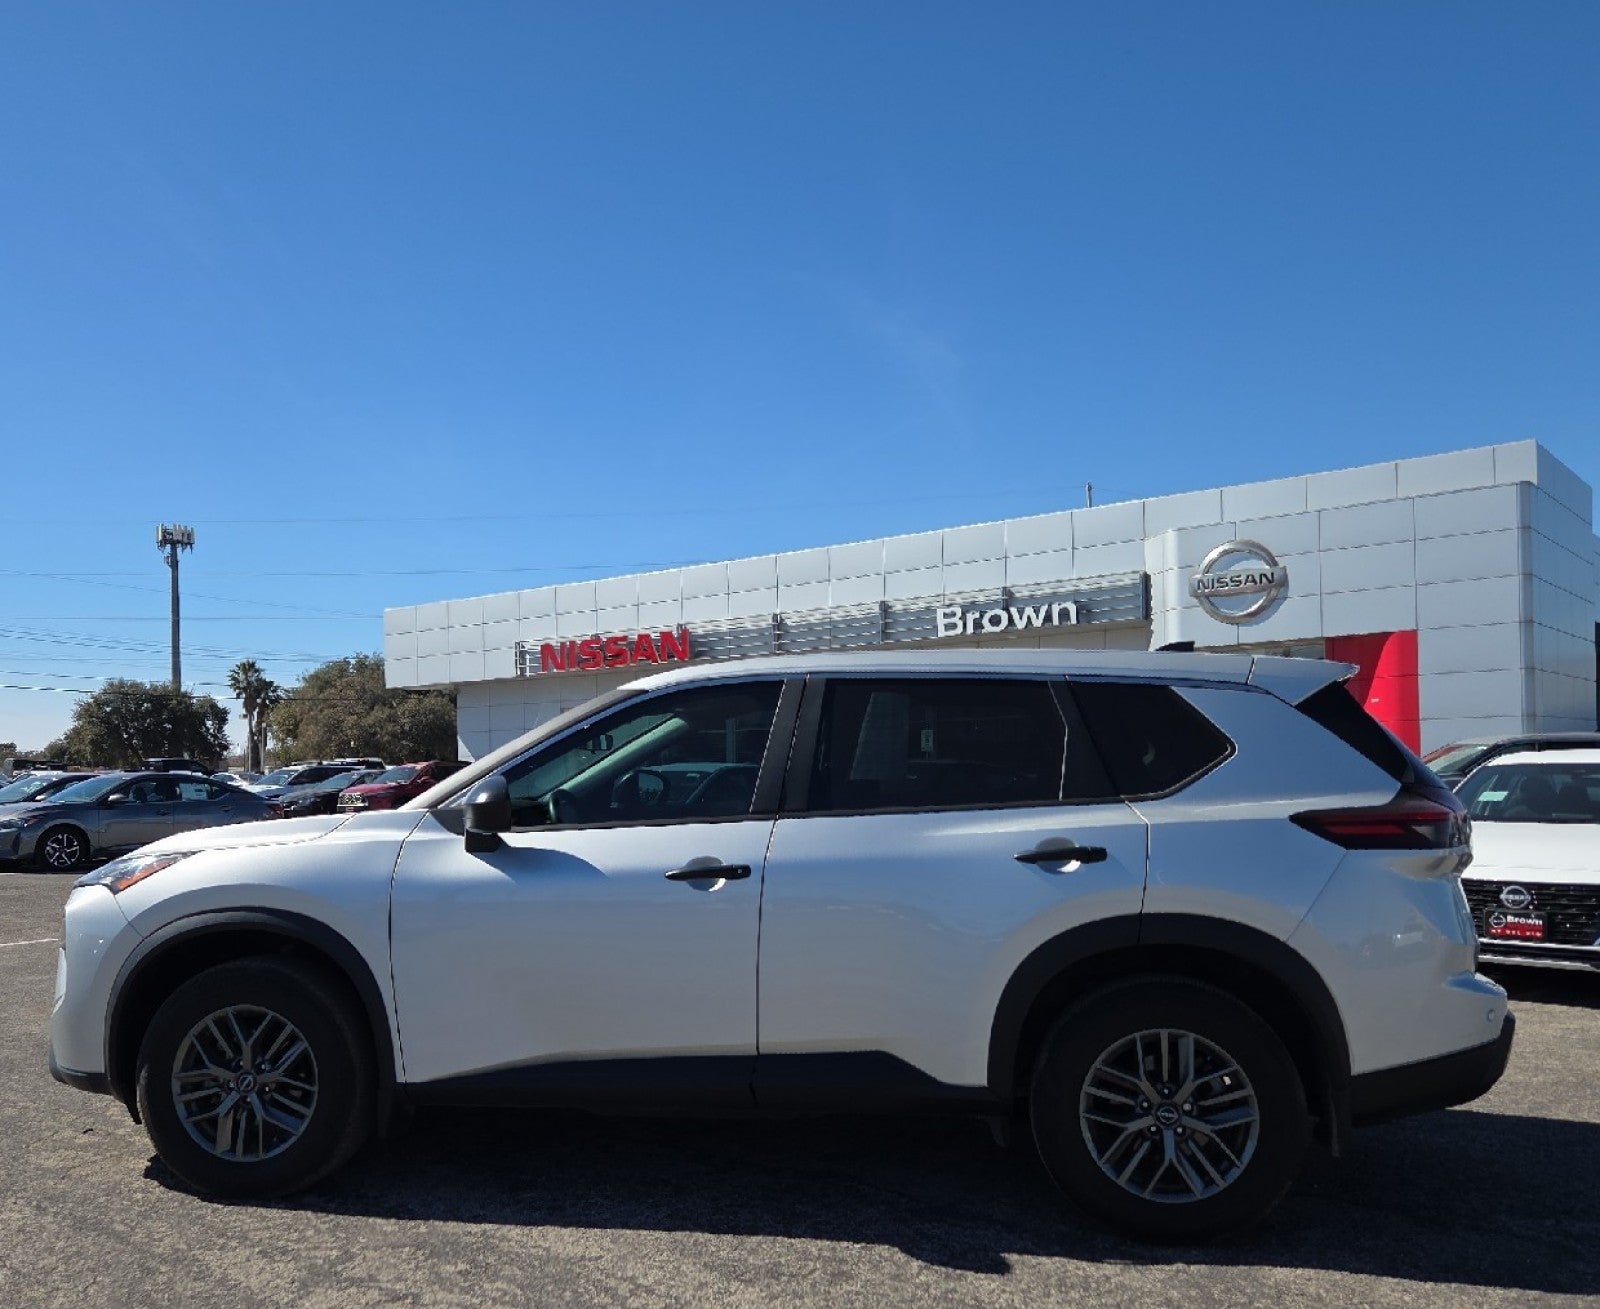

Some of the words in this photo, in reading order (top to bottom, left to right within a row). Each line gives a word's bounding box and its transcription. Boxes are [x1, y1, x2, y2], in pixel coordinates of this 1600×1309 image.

[1197, 572, 1275, 592] NISSAN
[936, 601, 1078, 637] Brown
[540, 628, 690, 673] NISSAN
[1506, 915, 1543, 926] Brown
